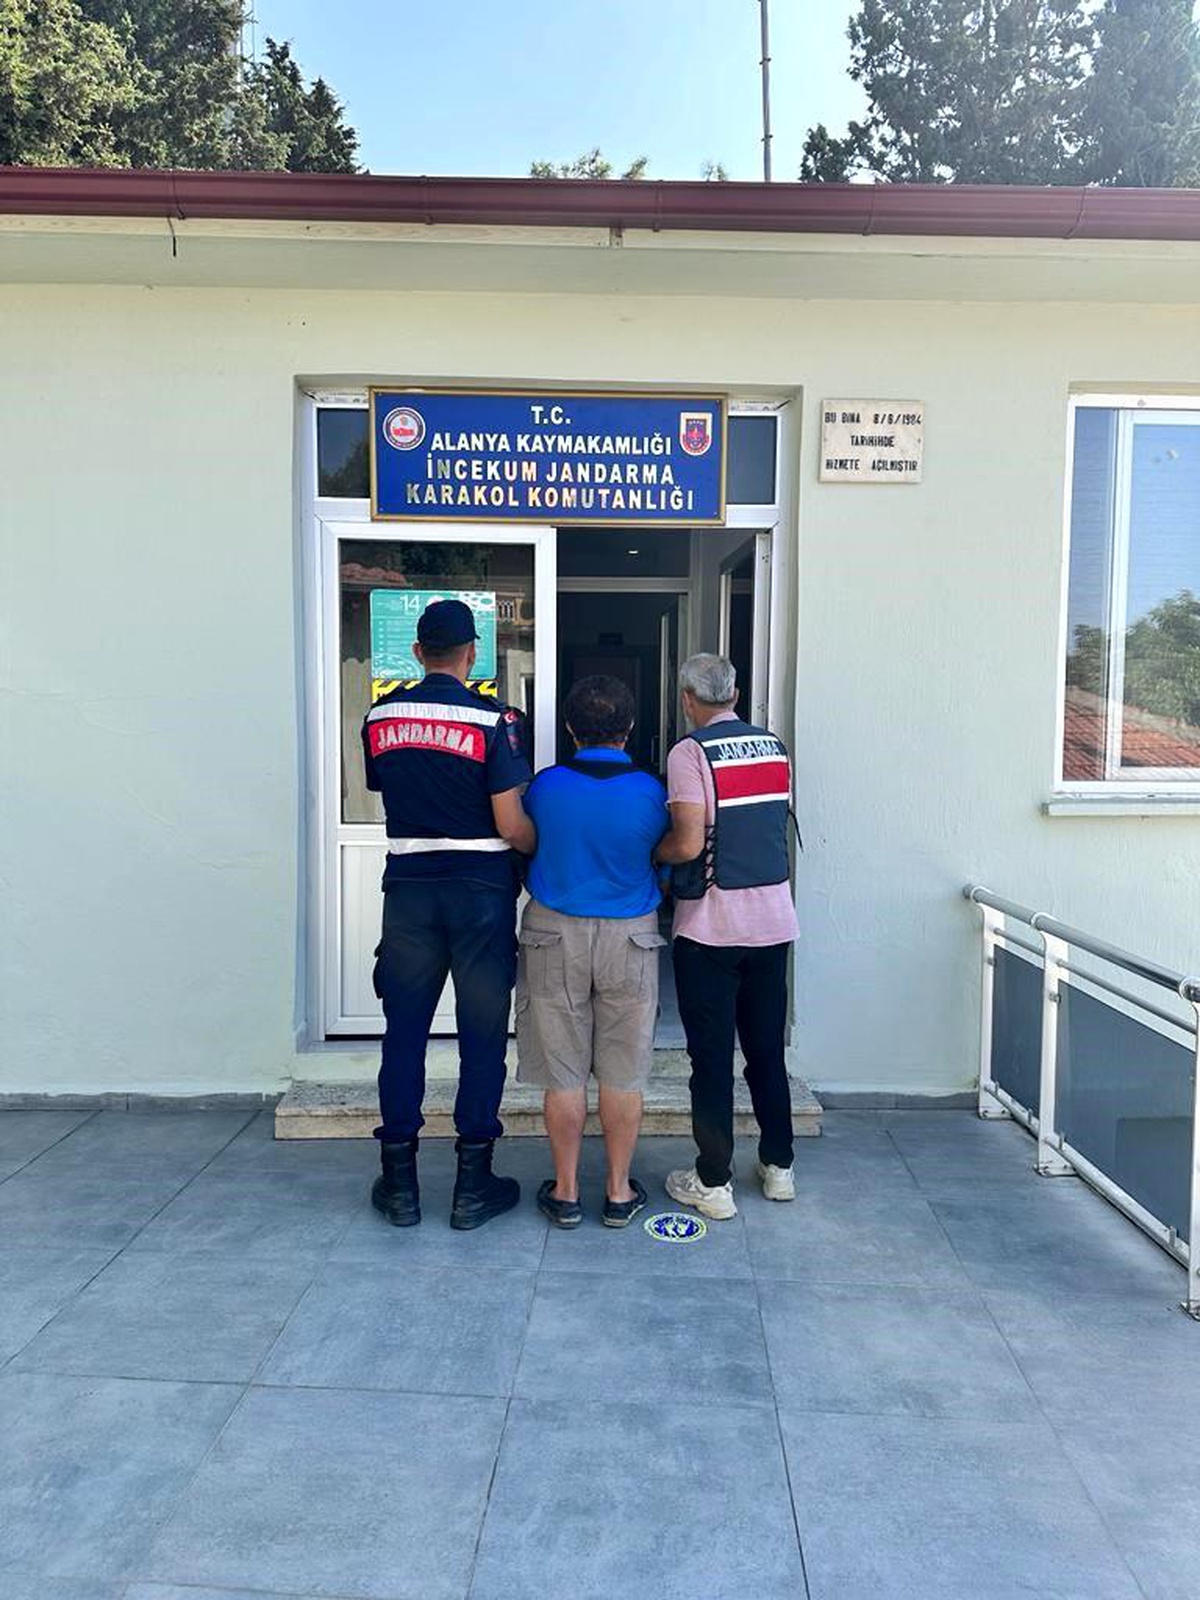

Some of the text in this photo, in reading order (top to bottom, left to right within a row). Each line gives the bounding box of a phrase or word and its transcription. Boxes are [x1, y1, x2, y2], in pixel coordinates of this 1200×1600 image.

[531, 406, 571, 425] T.C.
[825, 412, 836, 423] BU
[430, 432, 510, 453] ALANYA
[517, 433, 672, 456] KAYMAKAMLIĞI
[427, 453, 674, 484] İNCEKUM JANDARMA
[407, 483, 693, 511] KARAKOL KOMUTANLIĞI
[400, 594, 420, 611] 14
[377, 722, 475, 756] JANDARMA
[718, 740, 781, 761] JANDARMA
